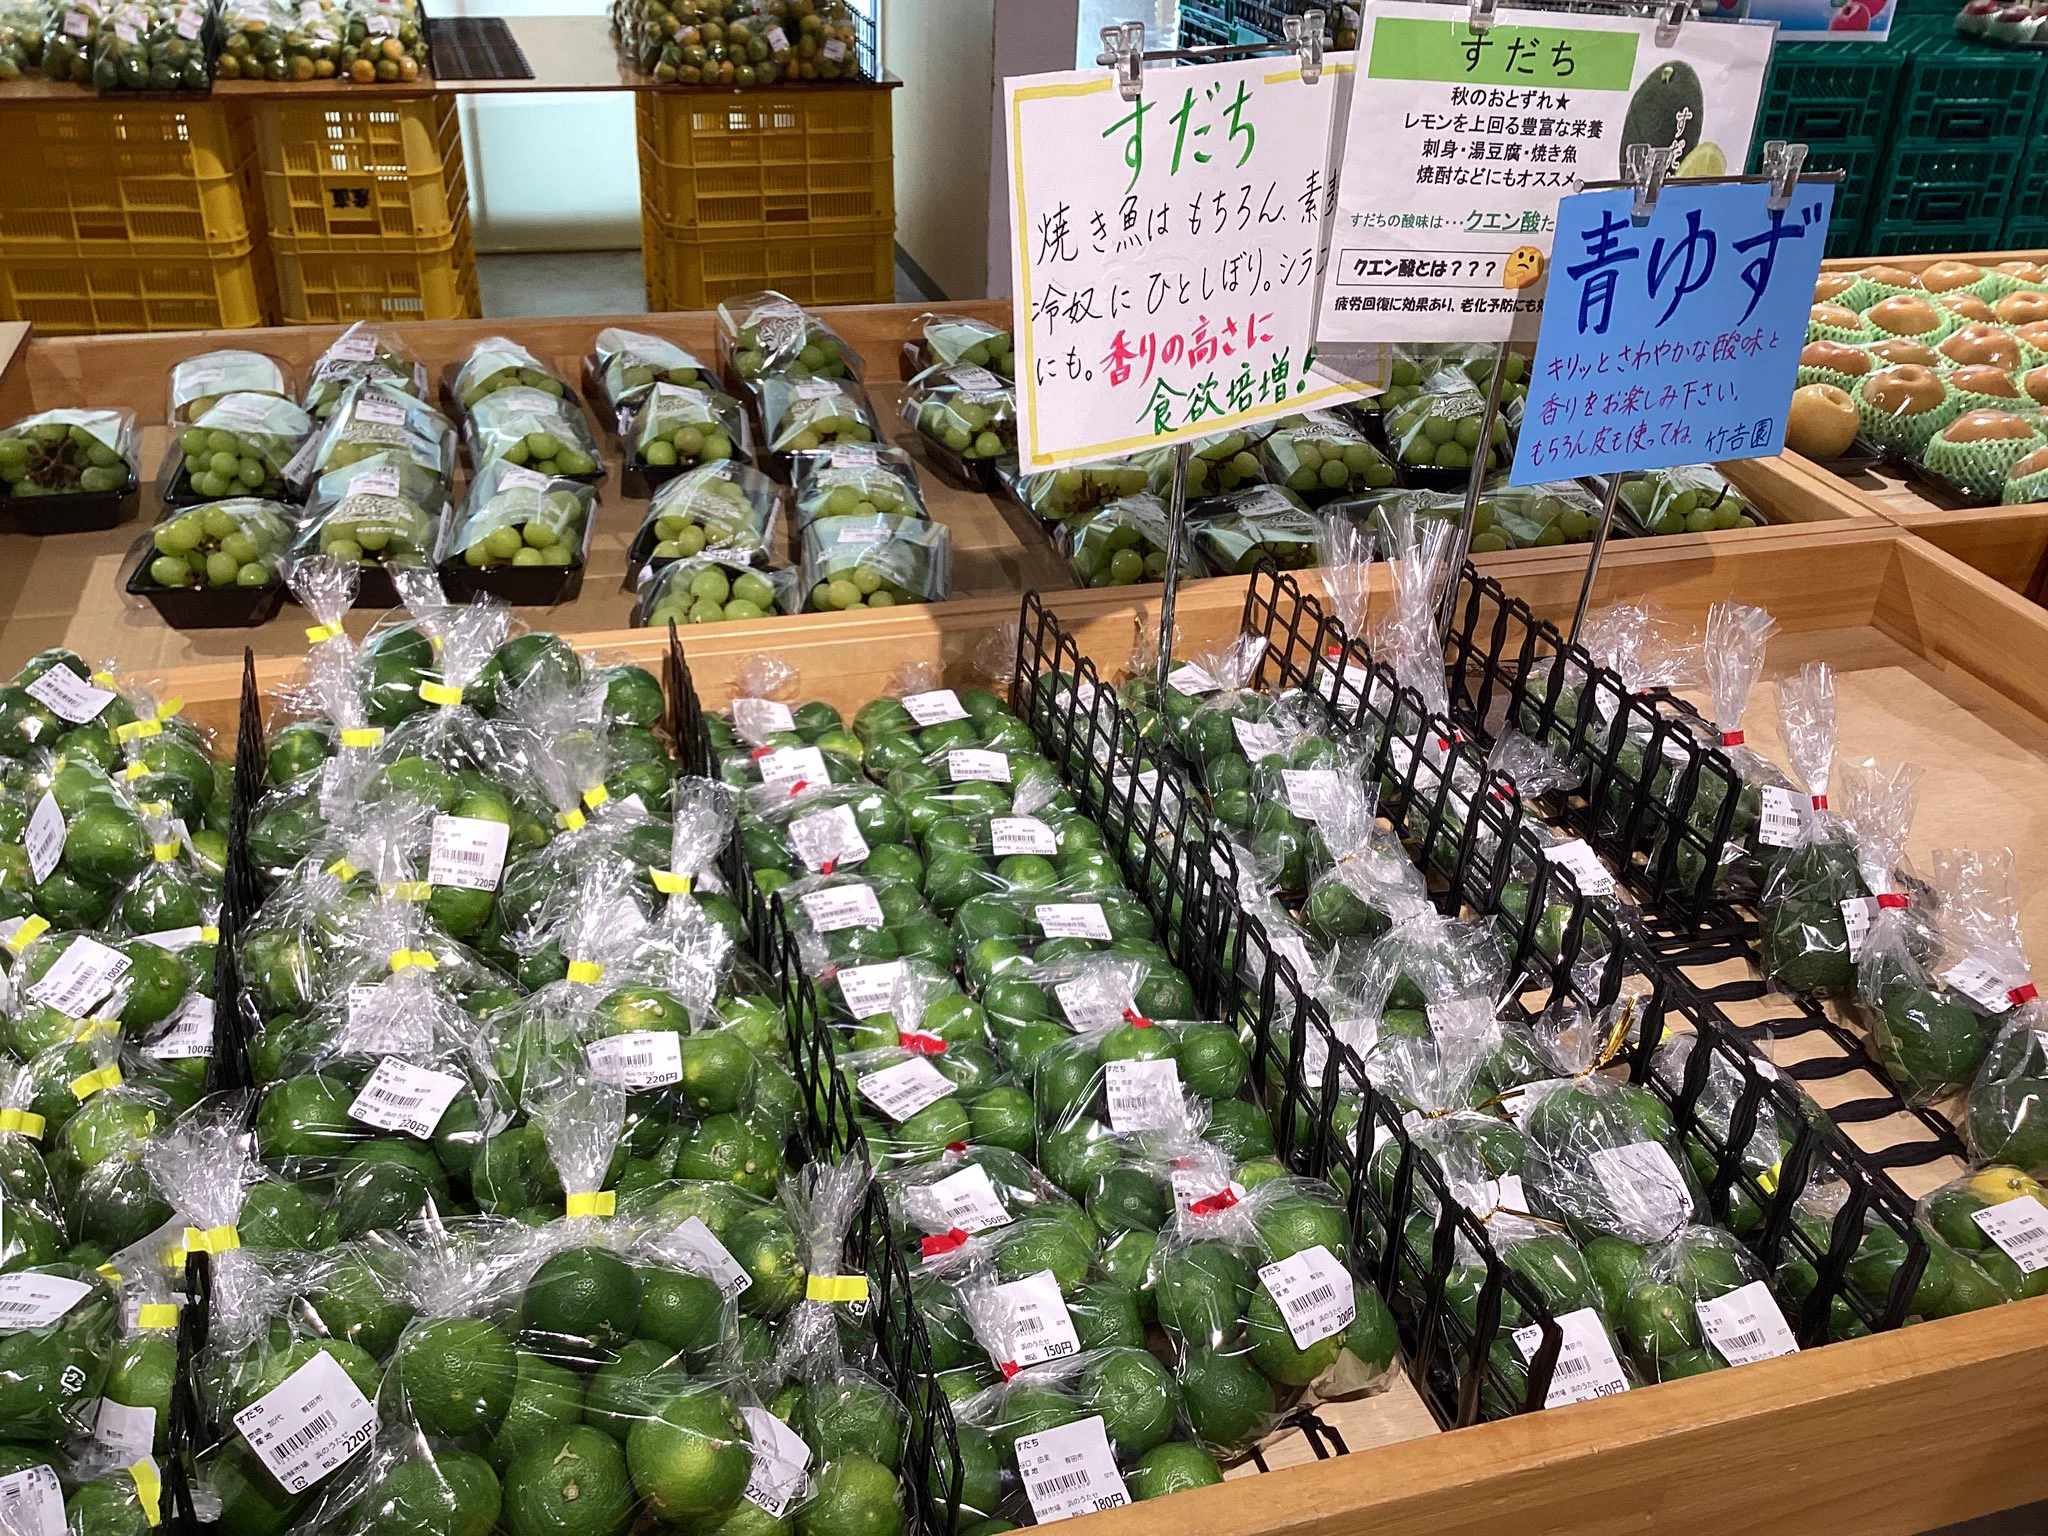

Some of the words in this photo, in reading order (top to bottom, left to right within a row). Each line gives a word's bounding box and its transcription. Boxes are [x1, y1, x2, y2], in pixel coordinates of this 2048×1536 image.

[1461, 34, 1575, 76] すだち
[1102, 79, 1256, 193] すだち
[1405, 112, 1603, 139] レモンを上回る豊富な栄養
[1421, 138, 1577, 164] 刺身・湯豆腐・焼き魚
[1665, 106, 1693, 178] すだ
[1416, 164, 1575, 188] 焼酎などにもオススメ
[1566, 202, 1822, 335] 青ゆず
[1036, 345, 1094, 387] にも。
[1100, 311, 1275, 388] 香りの高さに
[1547, 327, 1780, 381] キリッとさわやかな酸味と
[473, 877, 496, 890] 220円
[103, 958, 129, 982] 100円
[384, 1058, 407, 1072] すだち
[646, 1072, 678, 1085] 220円
[398, 1118, 430, 1137] 220円
[980, 1215, 1009, 1226] 150円
[1260, 1265, 1281, 1279] すだち
[1336, 1306, 1354, 1327] 200円
[1021, 1338, 1050, 1351] 浜のうたせ
[1515, 1329, 1538, 1342] すだち
[1025, 1353, 1038, 1362] 税込
[1044, 1340, 1074, 1358] 150円
[1570, 1379, 1600, 1394] 浜のうたせ
[1593, 1379, 1626, 1399] 150円
[300, 1393, 324, 1414] 有田市
[235, 1404, 265, 1427] すだち
[247, 1427, 263, 1441] 宮崎
[267, 1413, 285, 1428] 加代
[322, 1456, 339, 1470] 税込
[342, 1418, 379, 1455] 220円
[1016, 1438, 1040, 1453] すだち
[280, 1459, 311, 1482] 新鮮市場
[313, 1430, 350, 1460] 浜のうたせ
[1064, 1453, 1084, 1465] 有田市
[1023, 1467, 1039, 1478] 産地
[745, 1484, 781, 1514] 220円
[1036, 1504, 1062, 1519] 新鮮市場
[1067, 1492, 1100, 1508] 浜のうたせ
[1093, 1492, 1126, 1513] 180円
